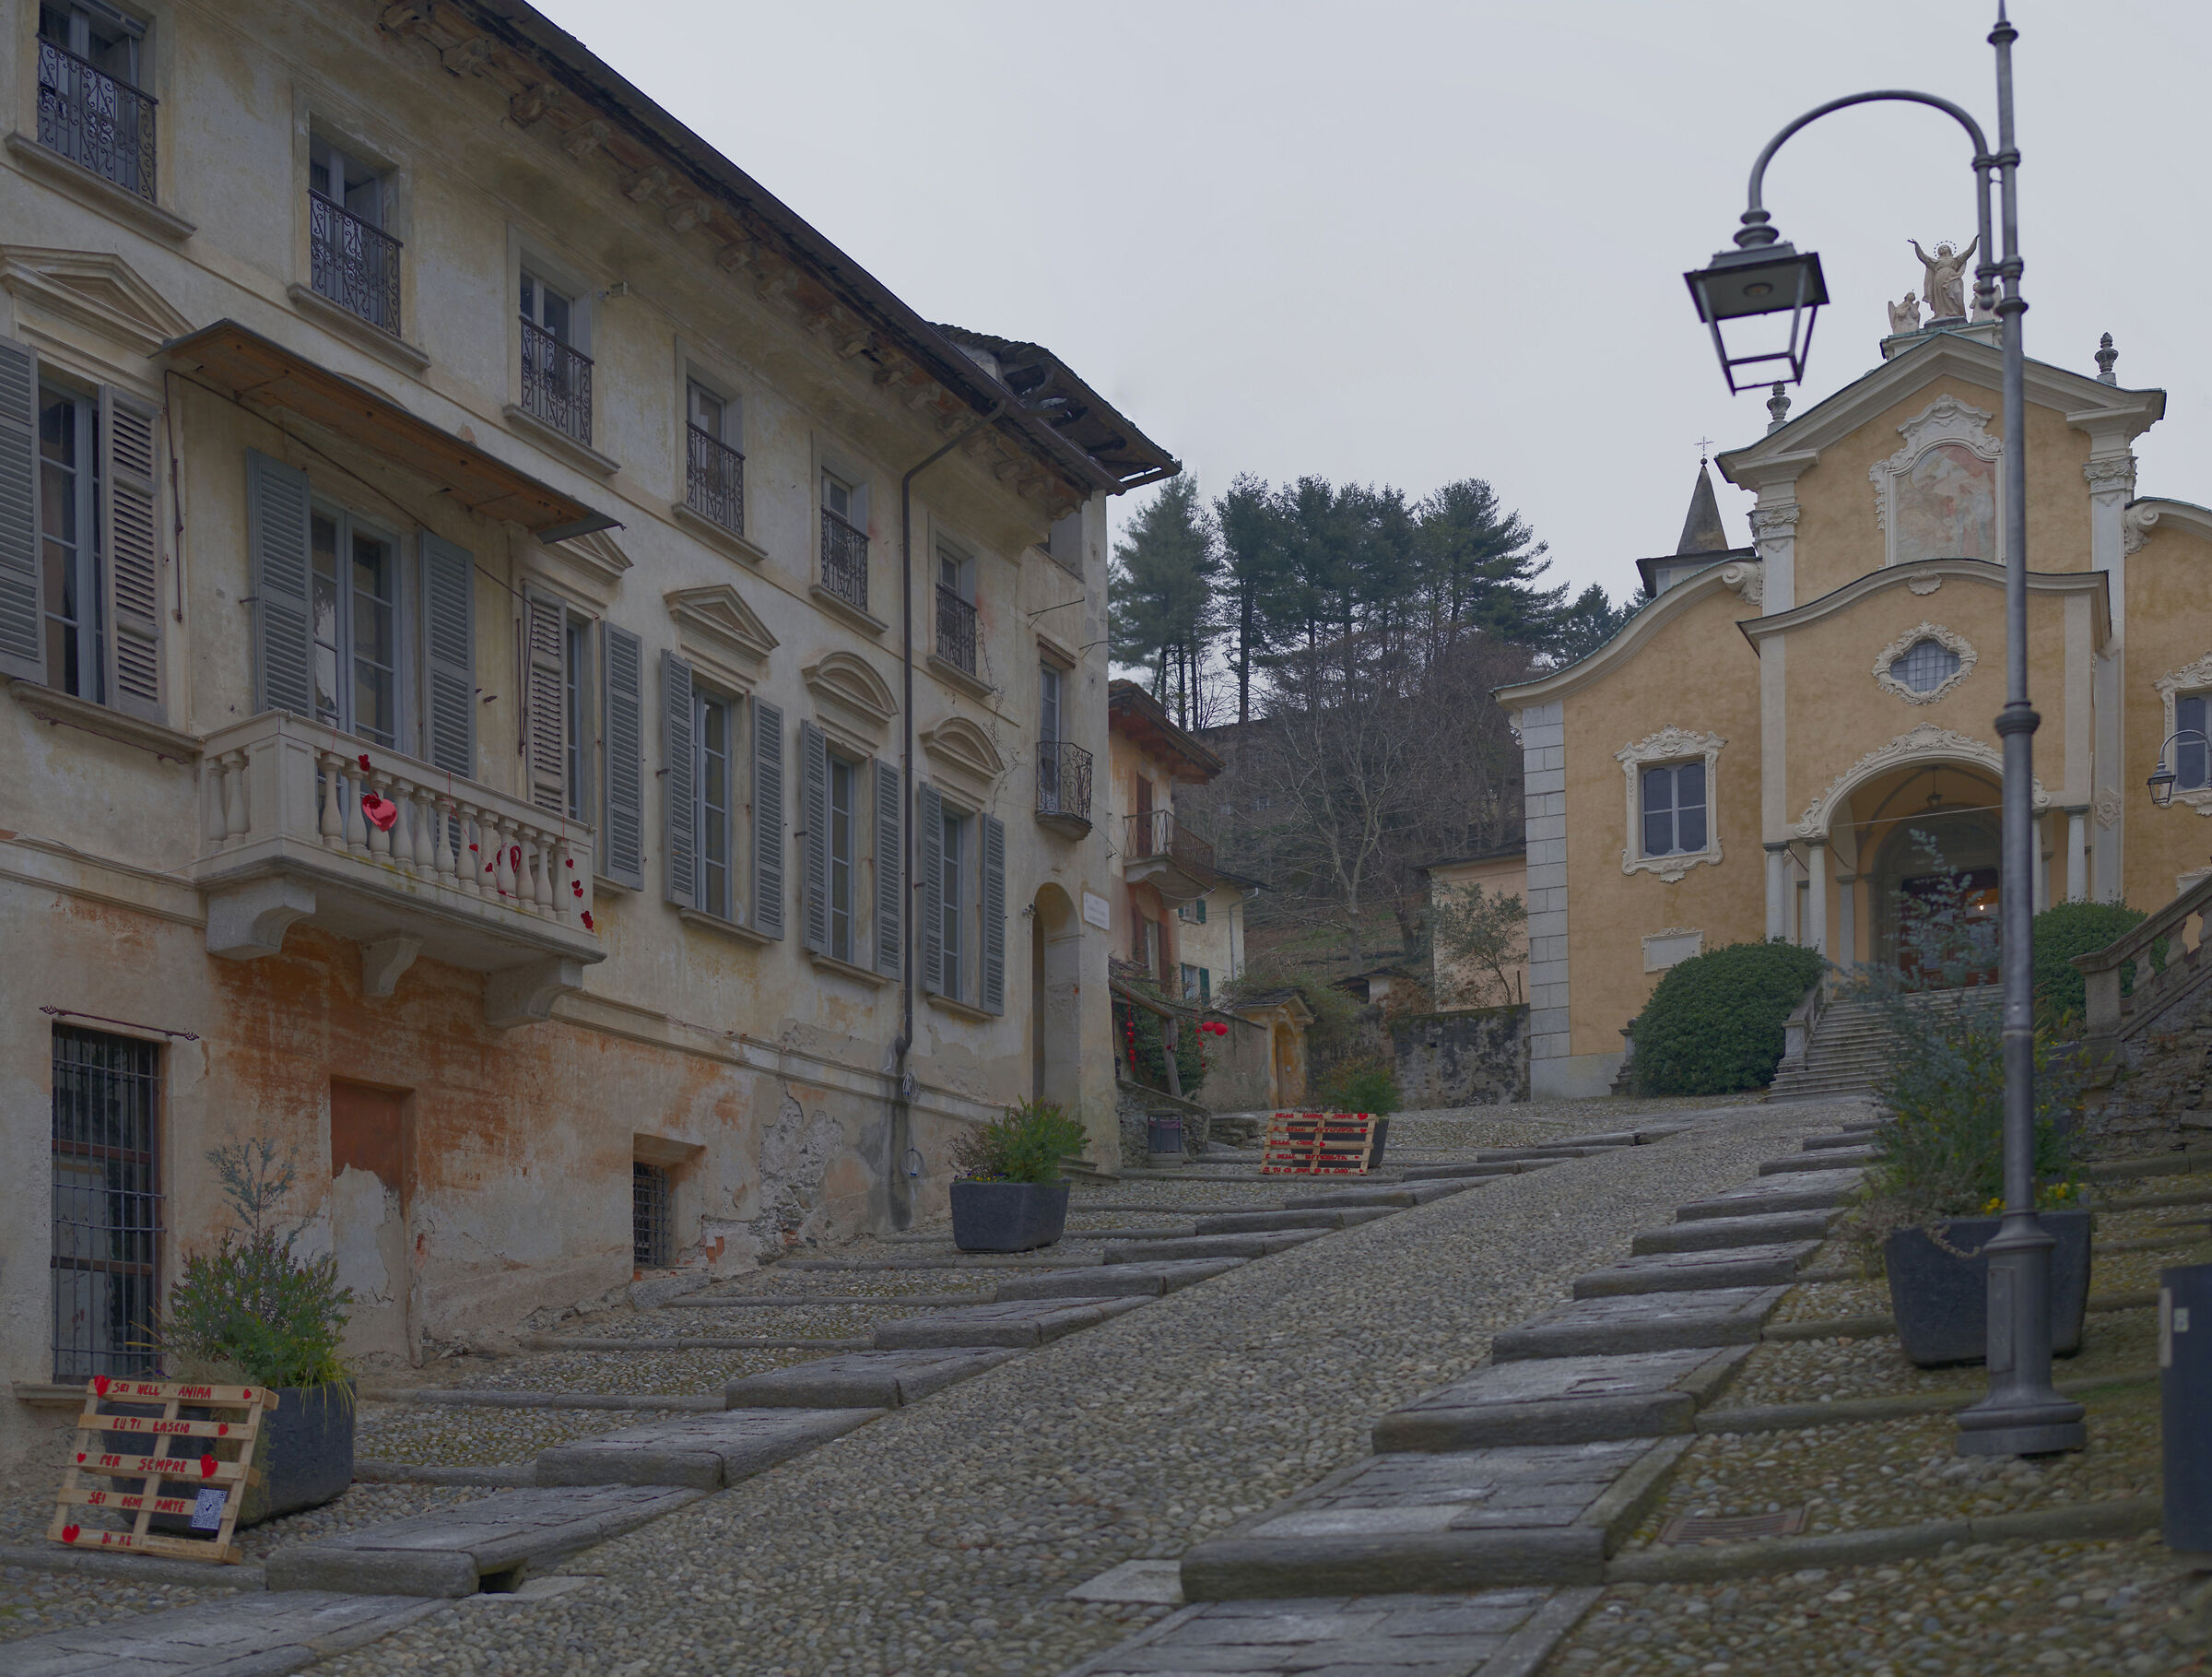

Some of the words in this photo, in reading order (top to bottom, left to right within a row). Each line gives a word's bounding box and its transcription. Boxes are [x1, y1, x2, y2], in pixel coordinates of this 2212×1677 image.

[112, 1382, 129, 1393] SEI
[178, 1386, 211, 1399] ANIMA
[152, 1421, 190, 1434] LASCIO
[100, 1454, 122, 1468] PER
[137, 1458, 187, 1473] SEMPRE
[88, 1491, 106, 1504] SEI
[121, 1497, 144, 1508] OGNI
[154, 1499, 186, 1513] PARTE
